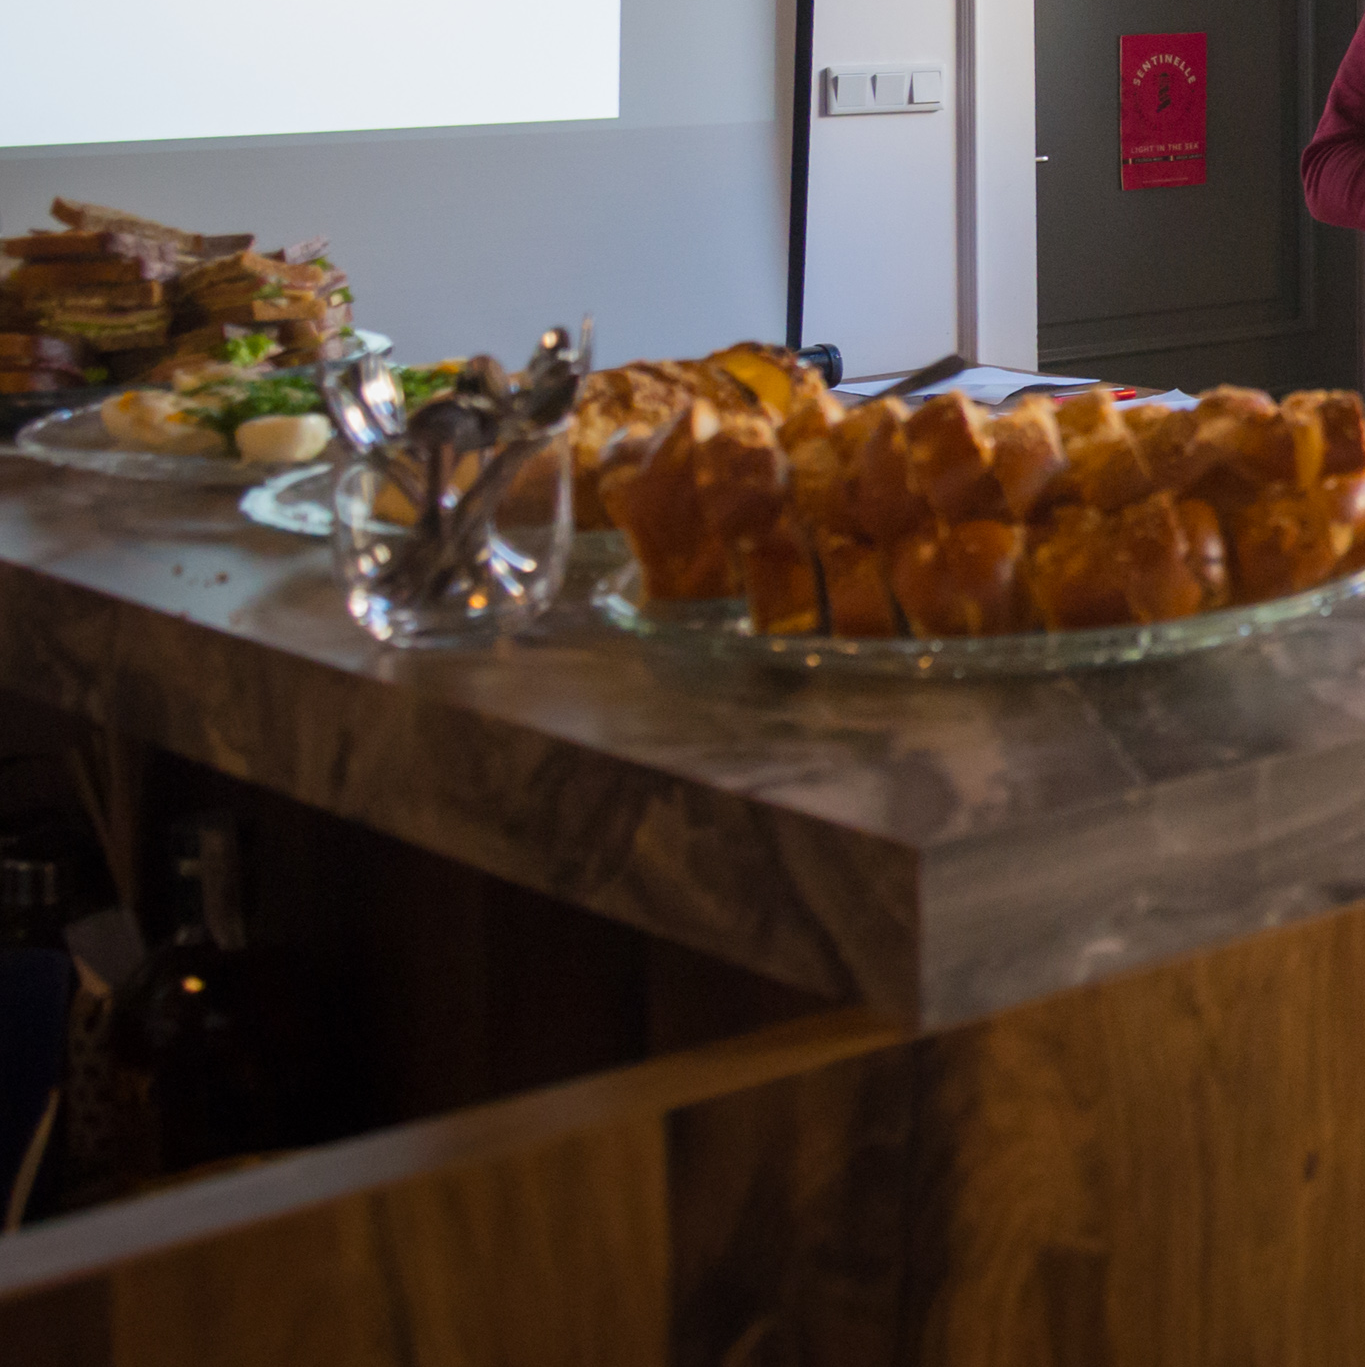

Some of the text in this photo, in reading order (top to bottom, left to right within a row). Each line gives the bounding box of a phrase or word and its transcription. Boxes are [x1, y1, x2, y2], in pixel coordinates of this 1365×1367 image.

[1133, 53, 1197, 87] SENTINELLE
[1130, 142, 1199, 154] LIGHT IN THE SEA
